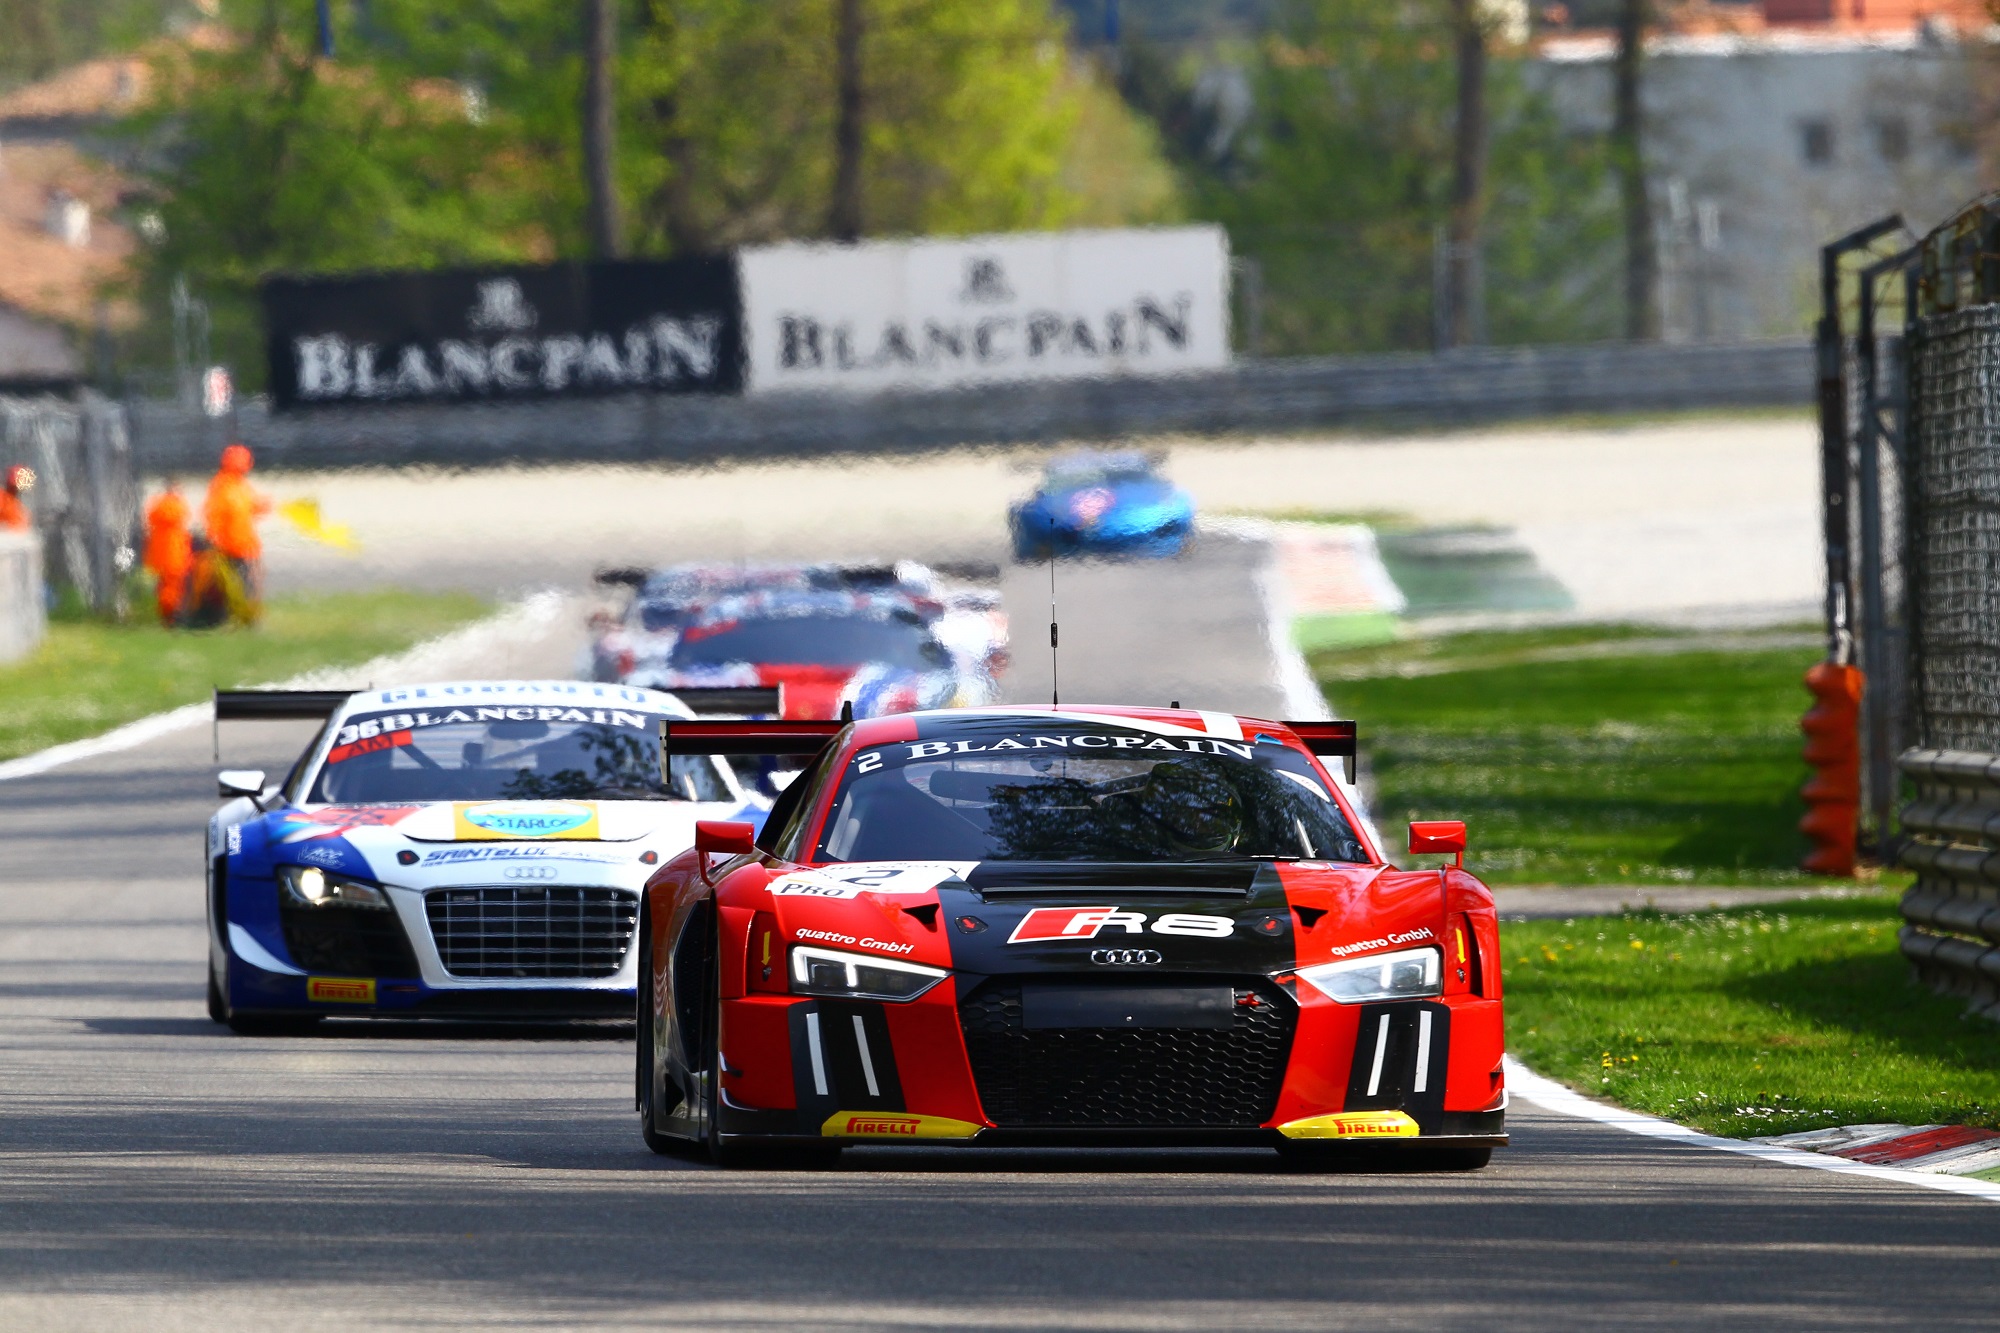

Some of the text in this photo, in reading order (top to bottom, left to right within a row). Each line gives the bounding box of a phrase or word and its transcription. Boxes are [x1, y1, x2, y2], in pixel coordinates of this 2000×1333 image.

[777, 290, 1192, 370] BLANCPAIN
[294, 314, 721, 397] BLANCPAIN
[339, 718, 381, 746] 36
[380, 707, 647, 733] BLANCPAIN
[906, 735, 1255, 760] BLANCPAIN
[858, 752, 883, 774] 2
[780, 883, 845, 896] PRO
[840, 870, 905, 886] 2
[1061, 911, 1235, 938] R8
[796, 928, 914, 954] quattro GmbH
[1331, 927, 1434, 956] quattro GmbH
[313, 982, 368, 999] PIRELLI
[846, 1117, 922, 1135] PIRELLI
[1333, 1117, 1400, 1135] PIRELLI
